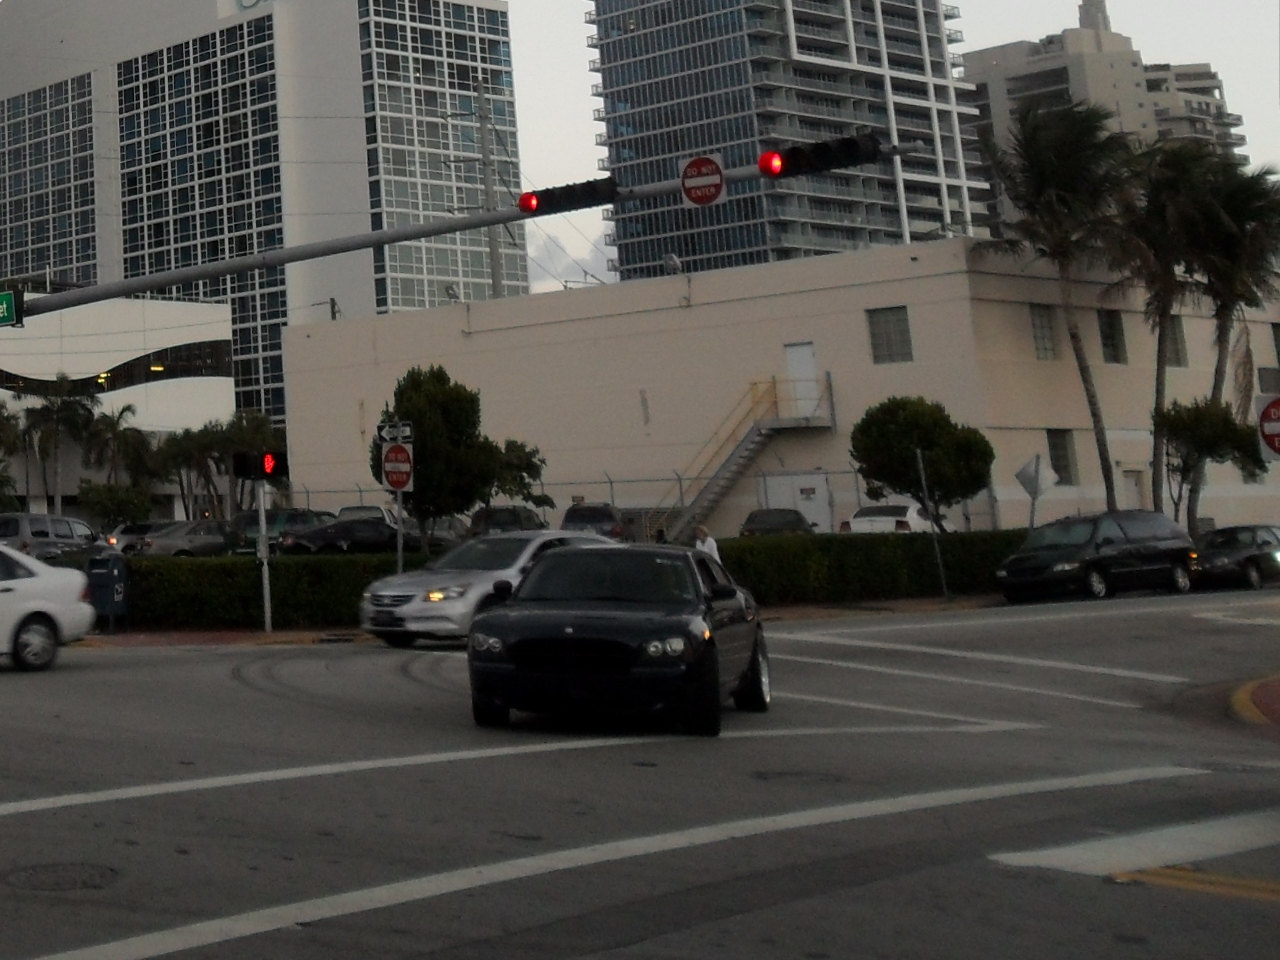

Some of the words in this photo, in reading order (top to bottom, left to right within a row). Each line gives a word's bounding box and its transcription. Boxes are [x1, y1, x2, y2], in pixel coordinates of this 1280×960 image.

[687, 167, 697, 176] DO
[701, 164, 717, 175] NOT
[691, 187, 715, 197] ENTER
